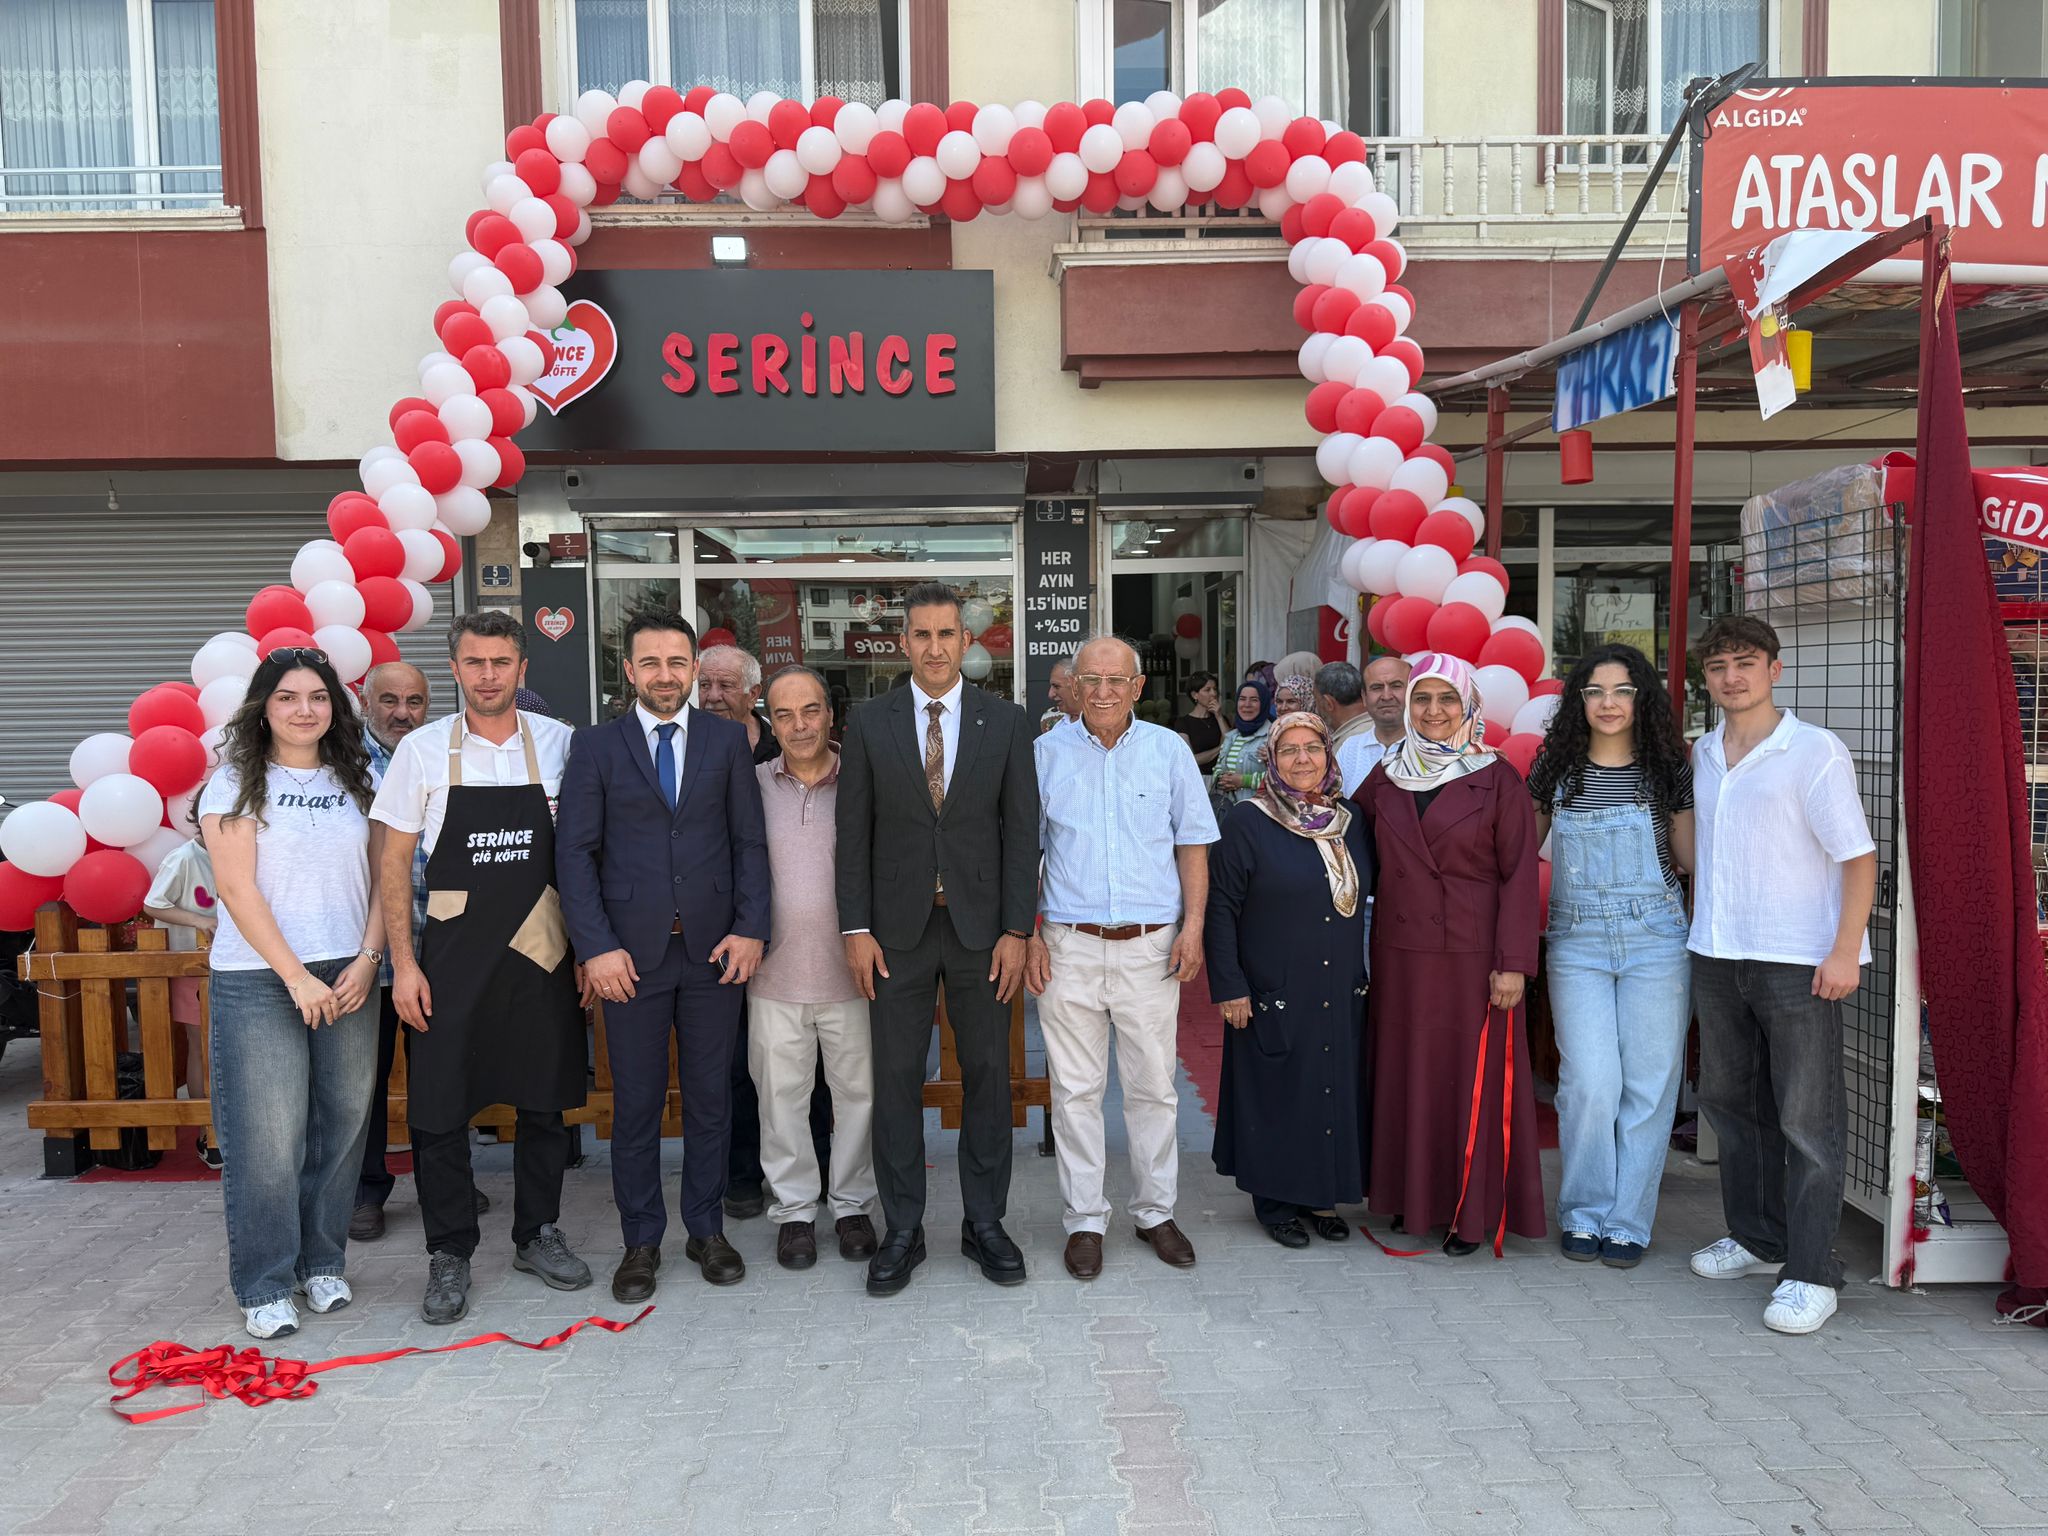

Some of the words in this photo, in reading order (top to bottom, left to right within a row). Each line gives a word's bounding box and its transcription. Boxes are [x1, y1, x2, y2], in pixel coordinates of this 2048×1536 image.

[1731, 153, 2003, 232] ATAŞLAR
[554, 345, 586, 361] NCE
[661, 311, 957, 395] SERİNCE
[1047, 500, 1053, 512] 5
[564, 535, 571, 545] 5
[1041, 551, 1072, 565] HER
[492, 566, 499, 578] 5
[1039, 574, 1074, 588] AYIN
[1026, 593, 1088, 611] 15'İNDE
[1034, 618, 1080, 633] +%50
[1598, 611, 1627, 630] 15
[1028, 641, 1083, 656] BEDAV
[277, 790, 347, 809] mavi
[466, 828, 534, 848] SERİNCE
[472, 850, 492, 866] ÇİĞ
[494, 848, 530, 863] KÖFTE
